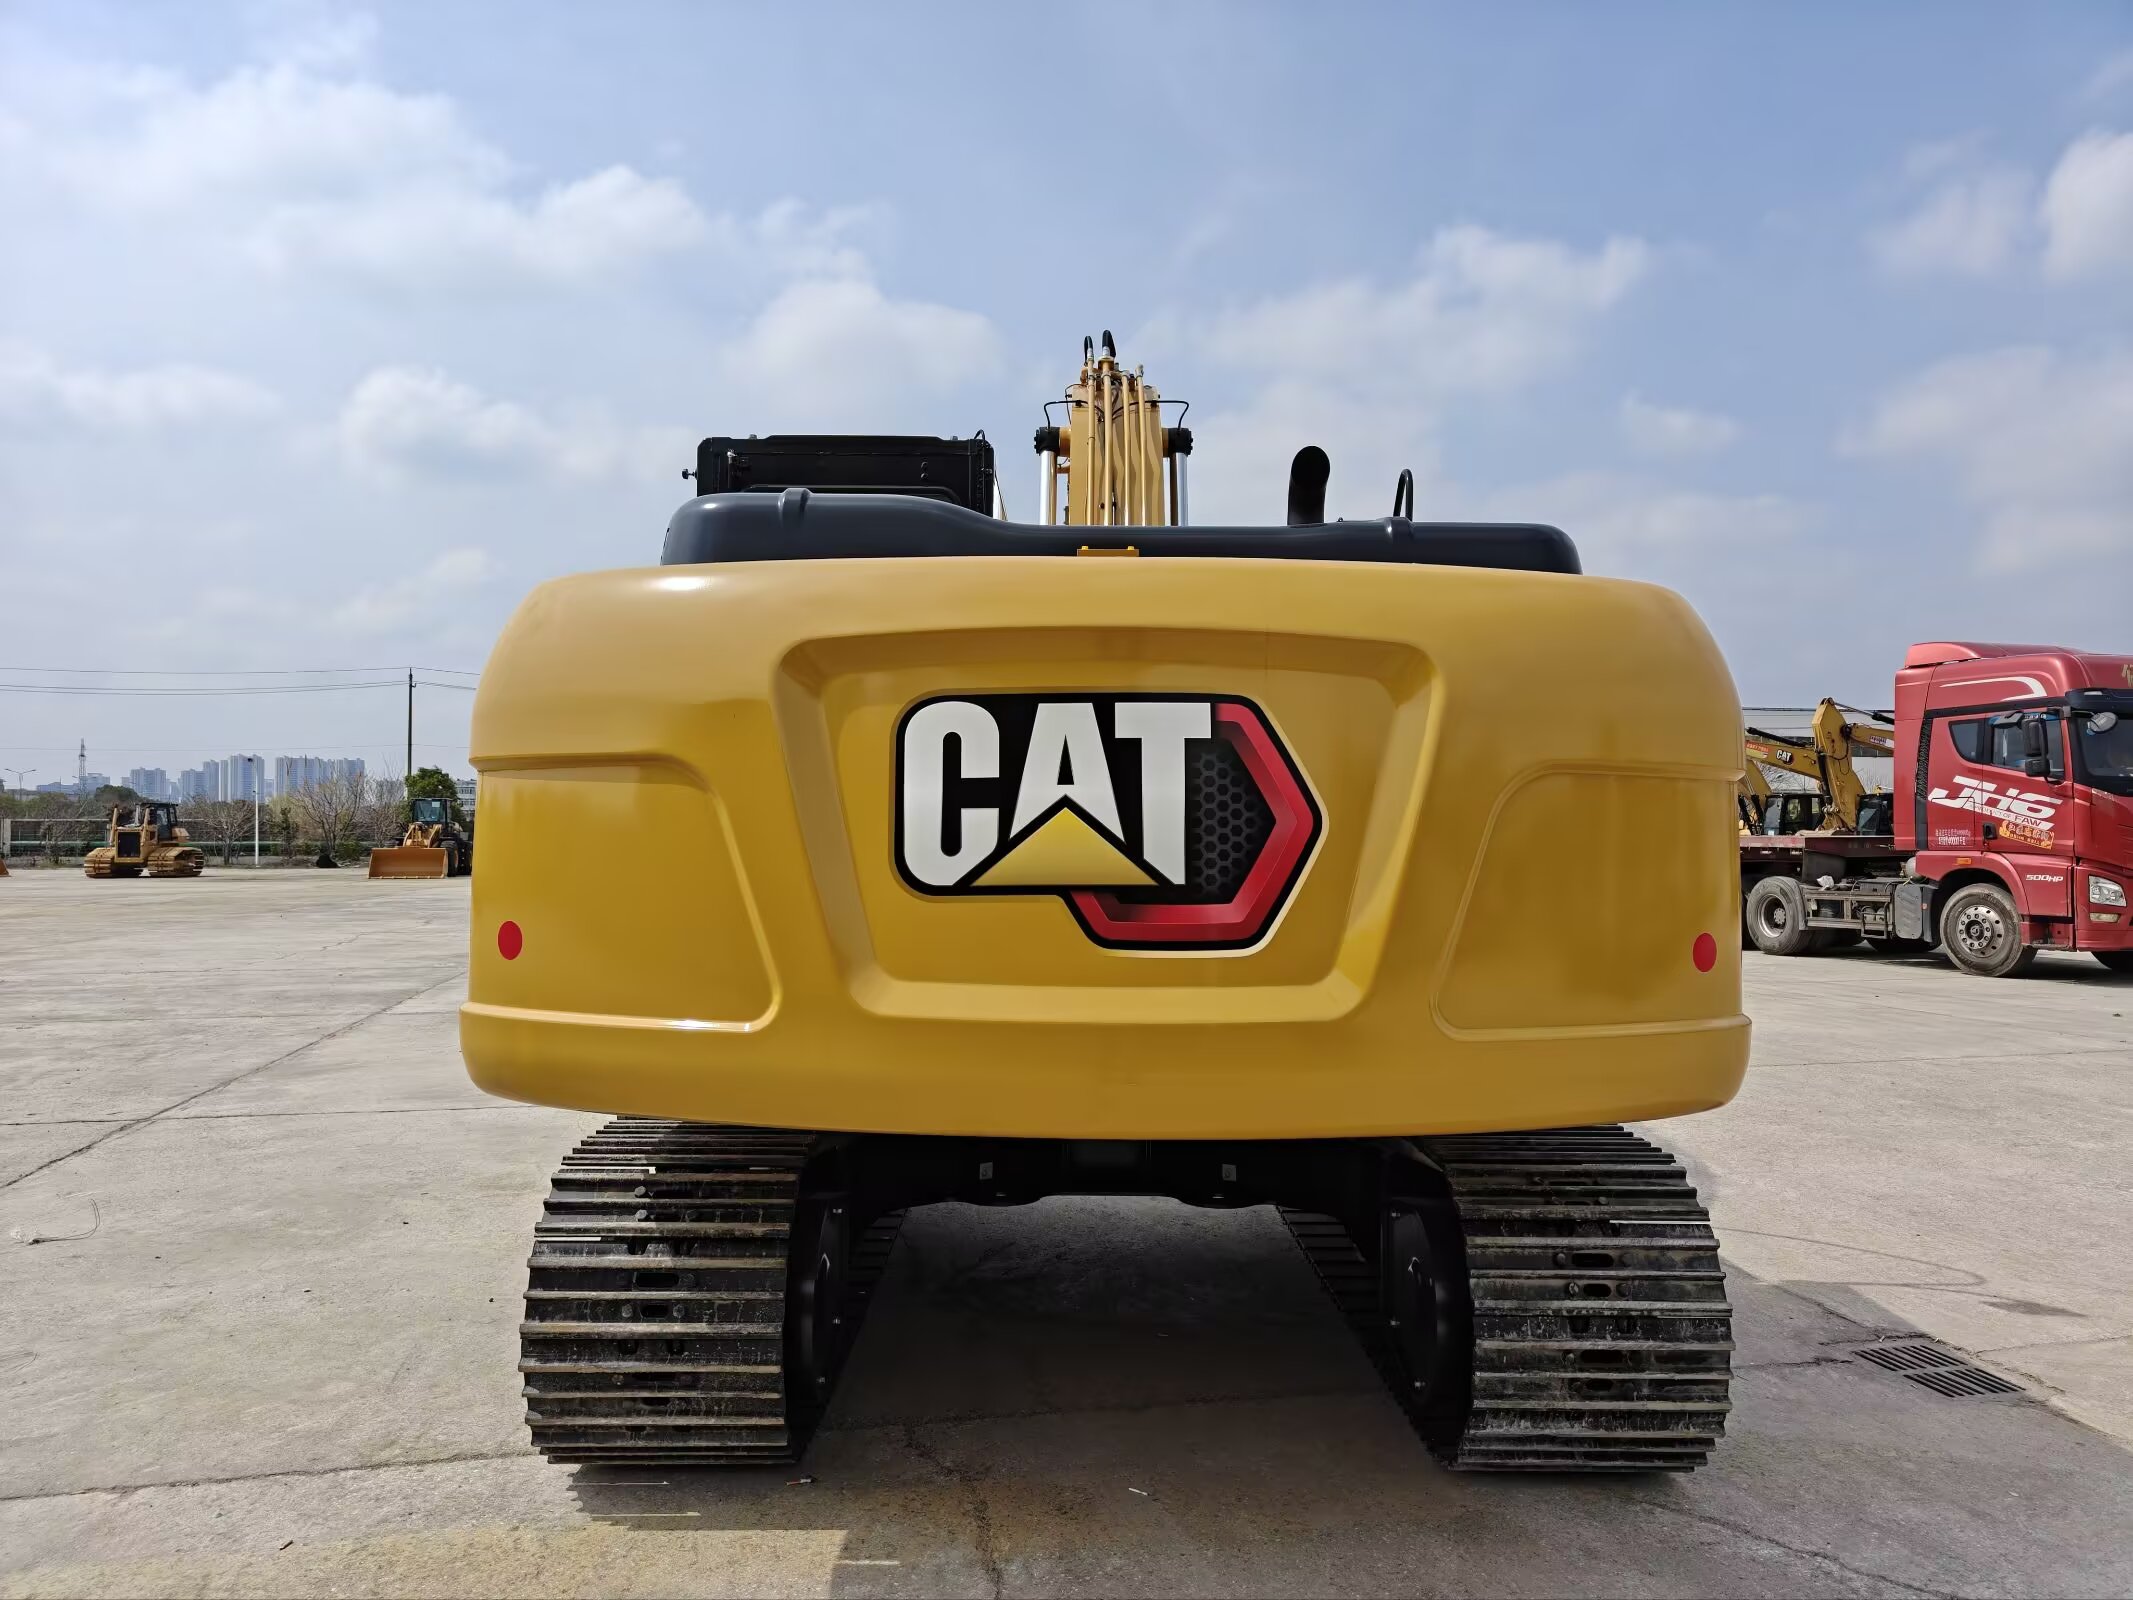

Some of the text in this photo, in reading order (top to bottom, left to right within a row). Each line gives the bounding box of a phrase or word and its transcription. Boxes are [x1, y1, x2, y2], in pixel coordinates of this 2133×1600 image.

[1776, 749, 1792, 762] CAT
[904, 701, 1212, 886] CAT
[1928, 775, 2063, 819] JH6
[2014, 815, 2041, 827] FAW
[2026, 874, 2064, 882] 500HP
